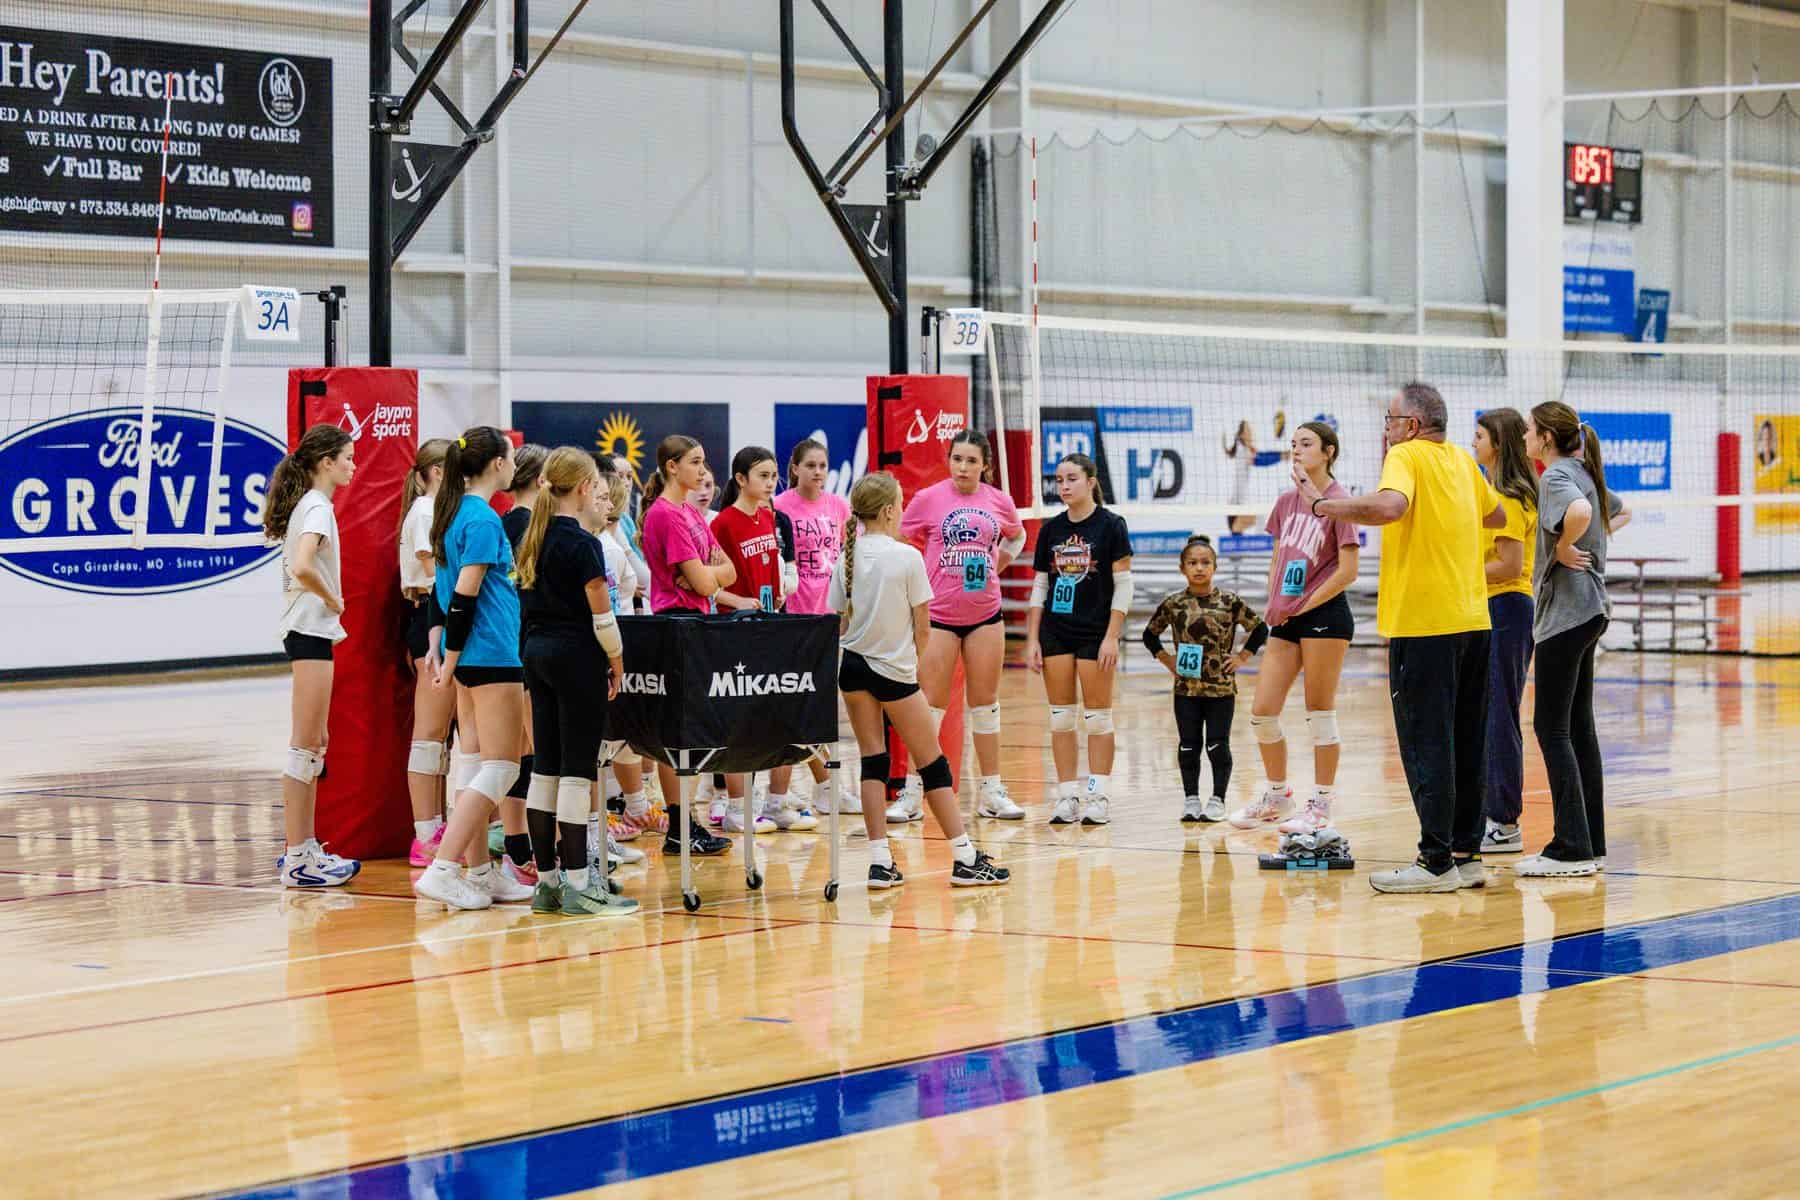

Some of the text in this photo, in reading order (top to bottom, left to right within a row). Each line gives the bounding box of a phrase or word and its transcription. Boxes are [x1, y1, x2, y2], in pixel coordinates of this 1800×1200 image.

[0, 42, 224, 106] Hey Parents!
[23, 109, 33, 124] A
[38, 109, 87, 127] DRINK
[90, 115, 136, 130] AFTER
[140, 118, 150, 132] A
[154, 118, 193, 136] LONG
[196, 121, 225, 138] DAY
[227, 124, 247, 139] OF
[26, 131, 50, 146] WE
[54, 132, 93, 149] HAVE
[96, 136, 126, 152] YOU
[62, 156, 143, 181] Full Bar
[187, 164, 312, 192] Kids Welcome
[258, 300, 289, 331] 3A
[953, 321, 979, 345] 3B
[373, 402, 413, 423] jaypro
[936, 409, 963, 428] jaypro
[372, 421, 412, 440] sports
[1047, 431, 1092, 466] HD
[12, 472, 267, 534] GROVES
[52, 555, 235, 576] Cape Girardeau, MO Since 1914
[966, 564, 985, 582] 64
[1285, 567, 1304, 586] 40
[1056, 585, 1073, 603] 50
[1179, 652, 1199, 671] 43
[618, 672, 667, 696] KASA
